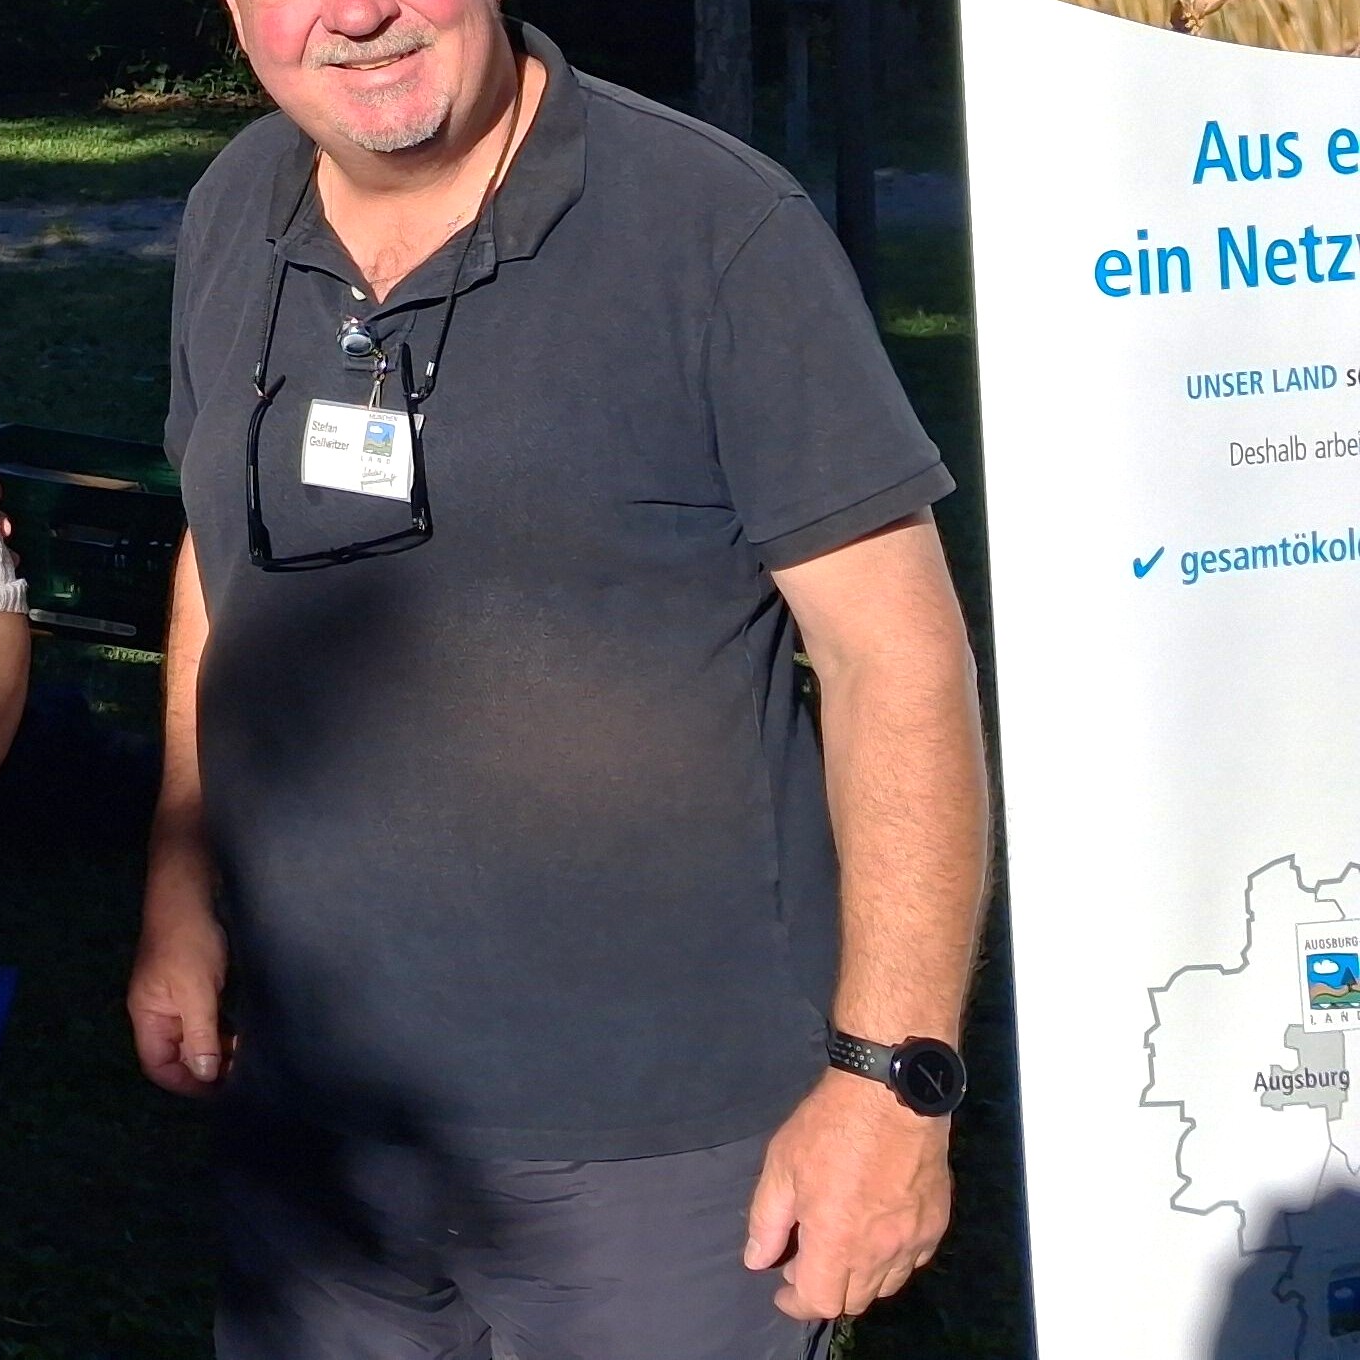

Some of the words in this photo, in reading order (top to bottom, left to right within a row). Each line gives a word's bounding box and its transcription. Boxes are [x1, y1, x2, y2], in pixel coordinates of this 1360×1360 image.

[1192, 120, 1303, 184] Aus
[1094, 228, 1192, 298] ein
[1218, 224, 1360, 290] Netz
[1186, 370, 1265, 401] UNSER
[1272, 364, 1338, 394] LAND
[1230, 434, 1308, 467] Deshalb
[1180, 527, 1360, 585] gesamtökol
[1253, 1067, 1350, 1096] Augsburg
